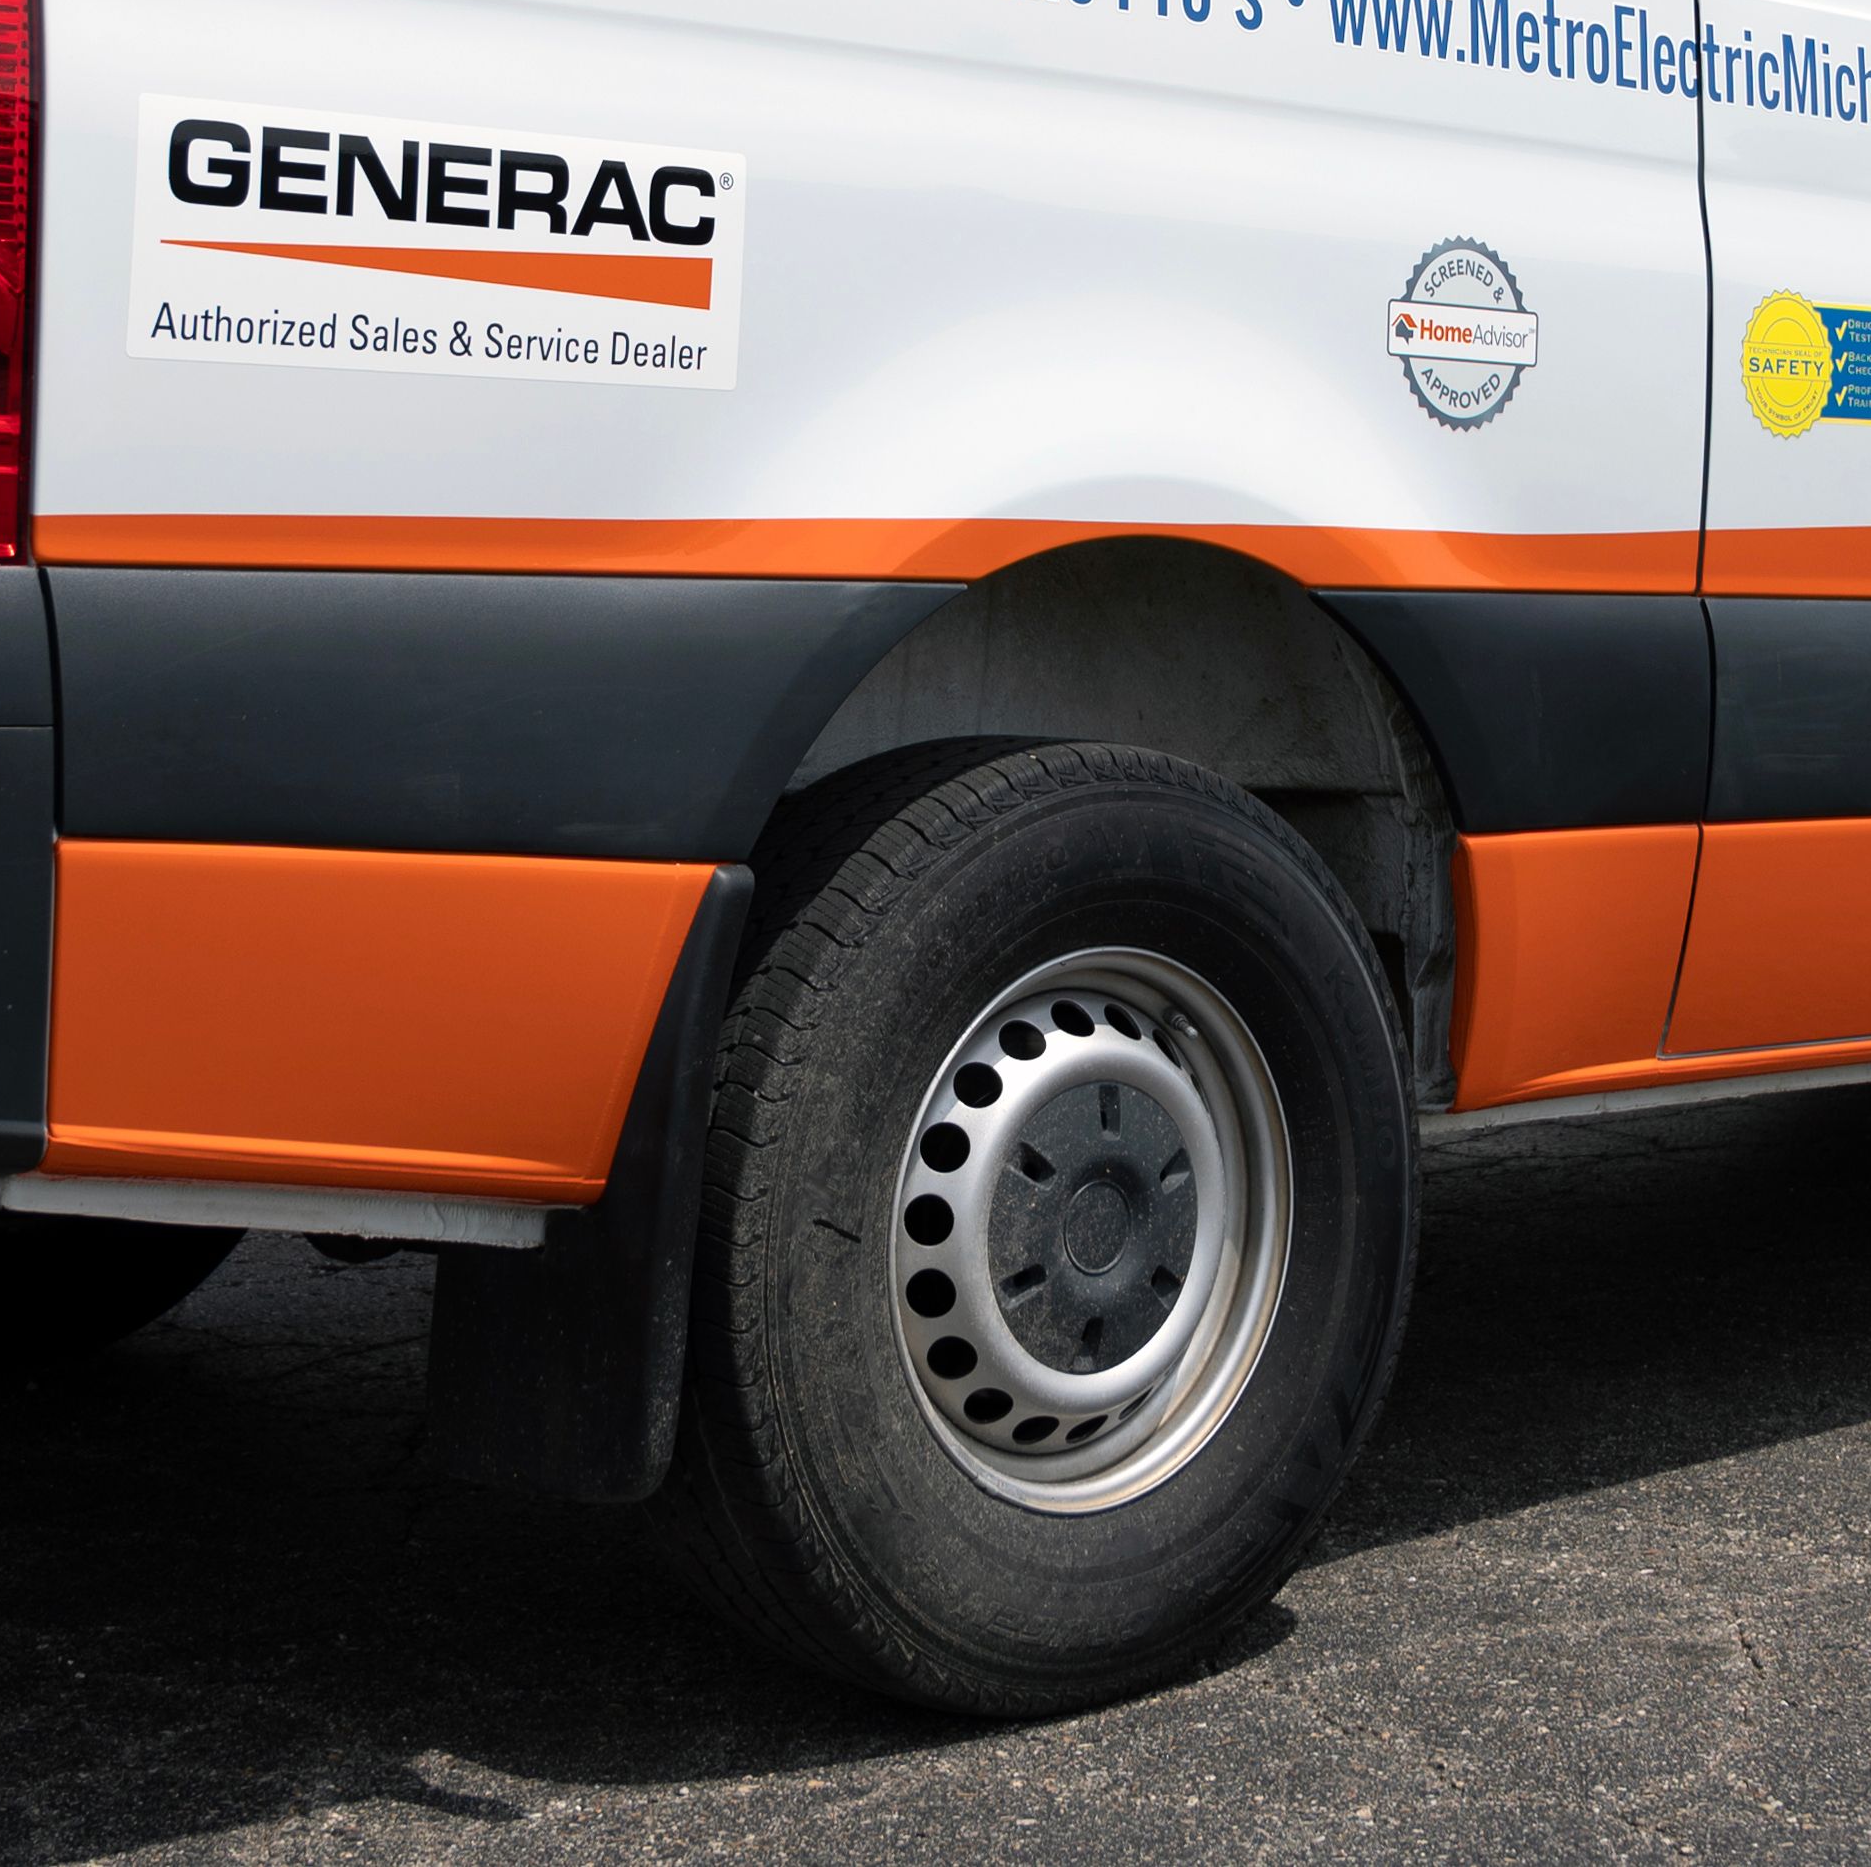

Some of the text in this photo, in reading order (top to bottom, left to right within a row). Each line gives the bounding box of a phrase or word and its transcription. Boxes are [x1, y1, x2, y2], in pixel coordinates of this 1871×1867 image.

[169, 119, 716, 246] GENERAC
[1424, 259, 1504, 305] SCREENED &
[150, 301, 708, 371] Authorized Sales & Service Dealer
[1420, 318, 1529, 349] HomeAdvisor
[1749, 357, 1824, 376] SAFETY
[1421, 368, 1502, 409] APPROVED
